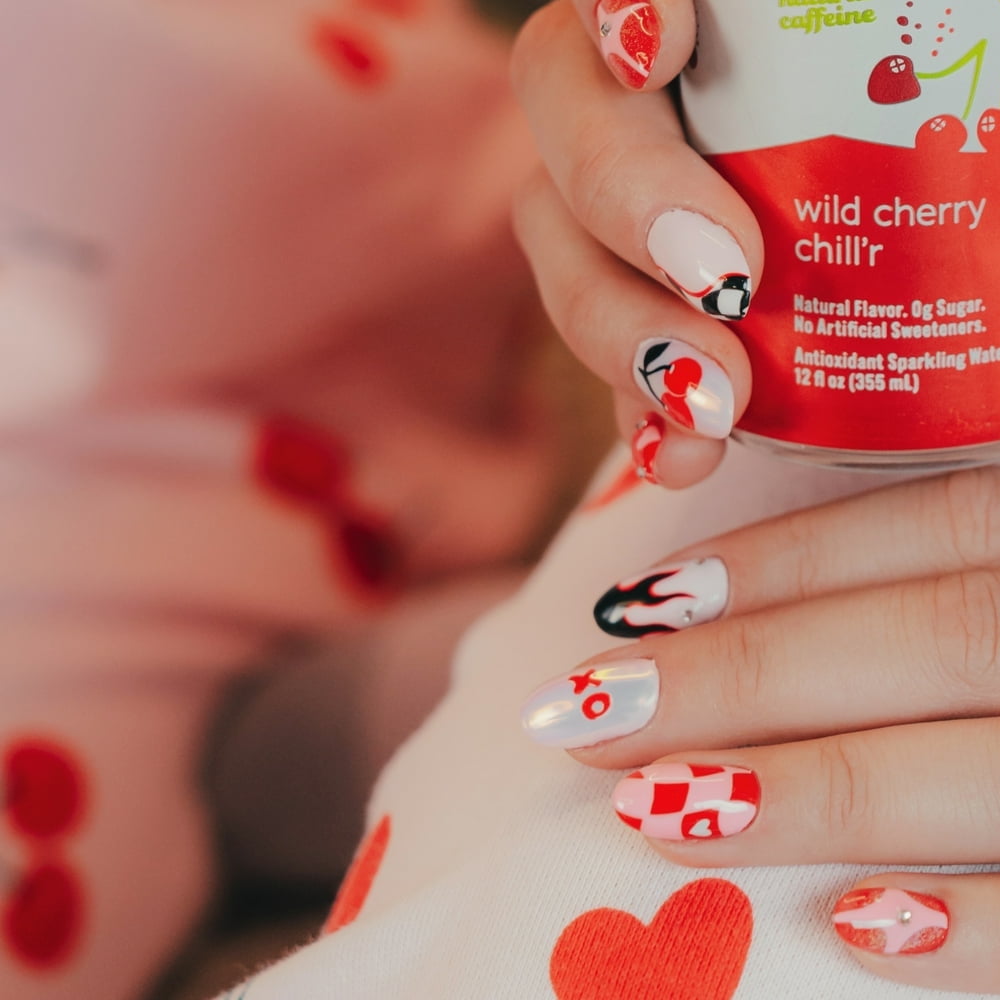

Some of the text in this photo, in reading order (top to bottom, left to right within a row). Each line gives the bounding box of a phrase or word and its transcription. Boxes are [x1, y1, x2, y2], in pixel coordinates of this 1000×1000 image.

[779, 5, 877, 35] caffeine
[794, 194, 987, 230] wild cherry
[794, 294, 850, 317] Natural
[854, 299, 908, 319] Flavor.
[936, 298, 986, 318] Sugar.
[794, 315, 987, 340] No Artificial Sweeteners.
[794, 346, 884, 371] Antioxidant
[887, 351, 967, 374] Sparkling
[794, 367, 811, 386] 12
[814, 370, 825, 388] fl
[828, 374, 845, 390] oz
[848, 373, 886, 394] (355
